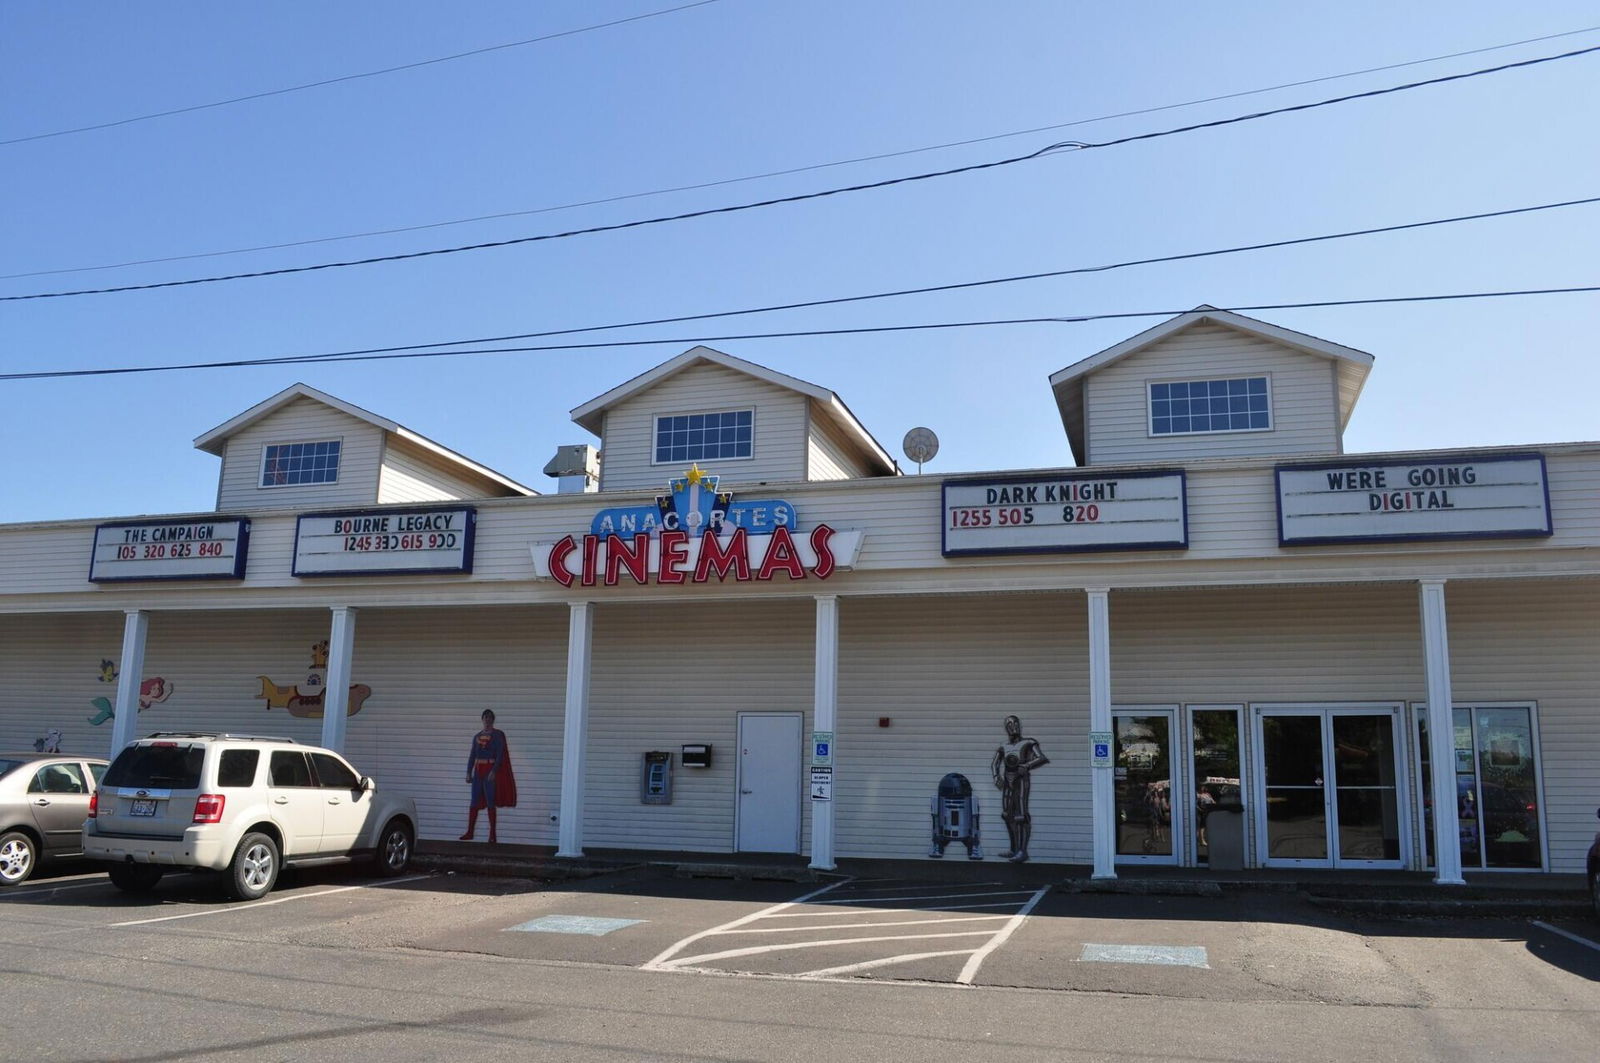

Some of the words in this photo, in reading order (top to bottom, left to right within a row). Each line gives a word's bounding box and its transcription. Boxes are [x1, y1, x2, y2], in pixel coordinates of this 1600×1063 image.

[1327, 471, 1387, 490] WERE
[1408, 466, 1476, 487] GOING
[986, 486, 1038, 505] DARK
[1045, 482, 1118, 503] KNIGHT
[1368, 490, 1455, 511] DIGITAL
[334, 517, 389, 534] BOURNE
[397, 515, 453, 531] LEGACY
[600, 504, 789, 533] ANACORTES
[952, 508, 992, 527] 1255
[998, 507, 1034, 525] 505
[1062, 504, 1099, 523] 820
[124, 528, 147, 543] THE
[152, 525, 214, 542] CAMPAIGN
[344, 536, 372, 551] 1245
[401, 534, 423, 549] 615
[117, 545, 136, 560] 105
[144, 544, 165, 559] 320
[170, 543, 191, 557] 625
[198, 542, 223, 556] 840
[548, 523, 837, 588] CINEMAS
